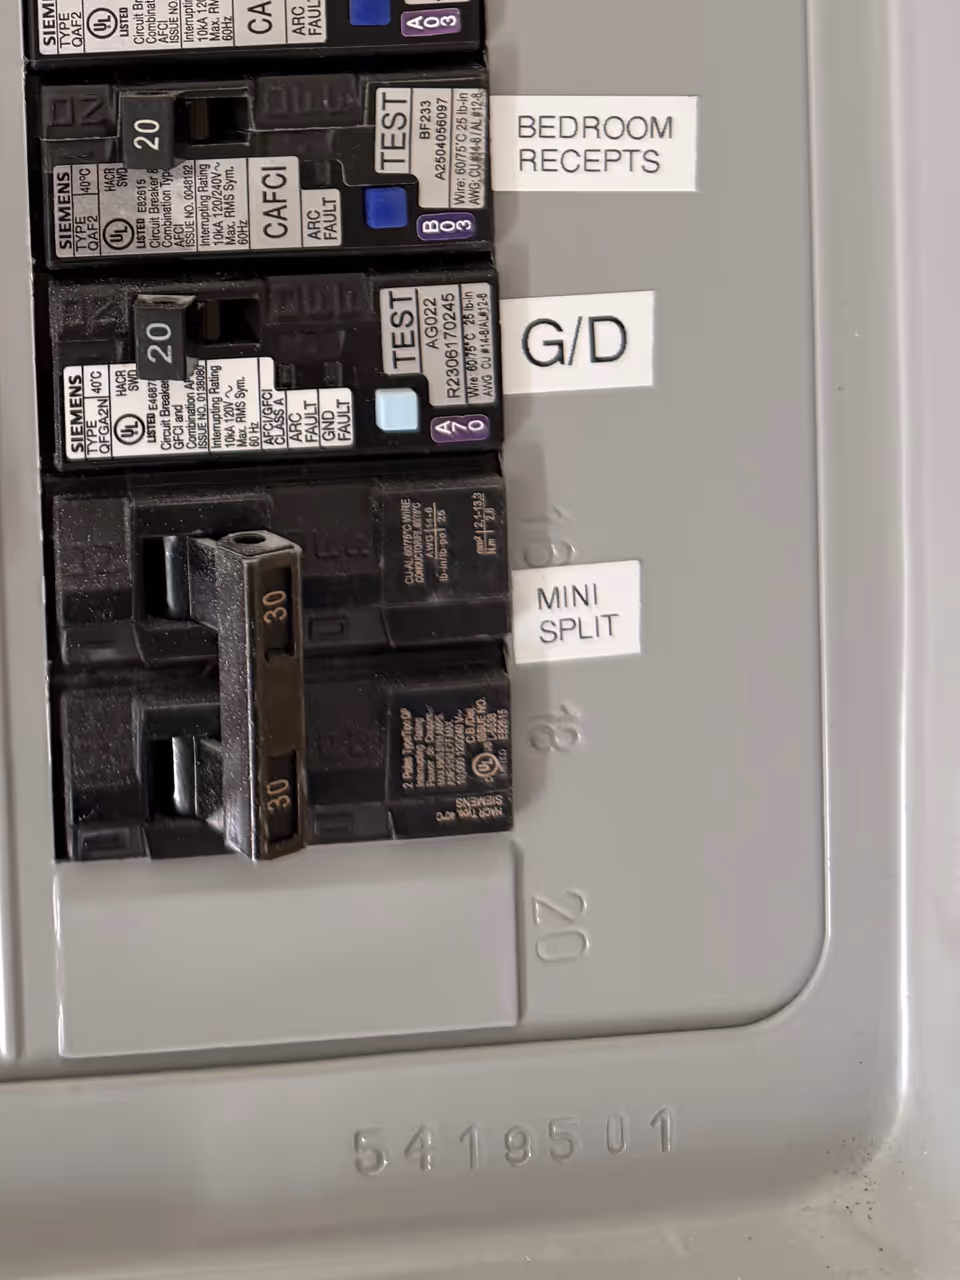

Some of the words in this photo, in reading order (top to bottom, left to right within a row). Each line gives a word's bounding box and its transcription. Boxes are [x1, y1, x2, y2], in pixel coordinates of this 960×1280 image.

[59, 12, 70, 48] TYPE
[71, 11, 83, 47] QAF2
[119, 7, 129, 37] LISTED
[134, 12, 145, 45] Circuit
[291, 6, 305, 36] ARC
[133, 119, 160, 150] 20
[381, 92, 407, 170] TEST
[420, 100, 430, 139] BF233
[517, 115, 672, 140] BEDROOM
[519, 148, 660, 173] RECEPTS
[57, 172, 72, 249] SIEMENS
[261, 166, 288, 238] CAFCI
[389, 291, 416, 369] TEST
[423, 298, 439, 349] AG022
[522, 314, 628, 366] G/D
[146, 322, 172, 363] 20
[69, 374, 84, 453] SIEMENS
[263, 590, 287, 622] 30
[537, 583, 599, 611] MINI
[539, 612, 619, 644] SPLIT
[266, 779, 290, 808] 30
[531, 889, 590, 963] 20
